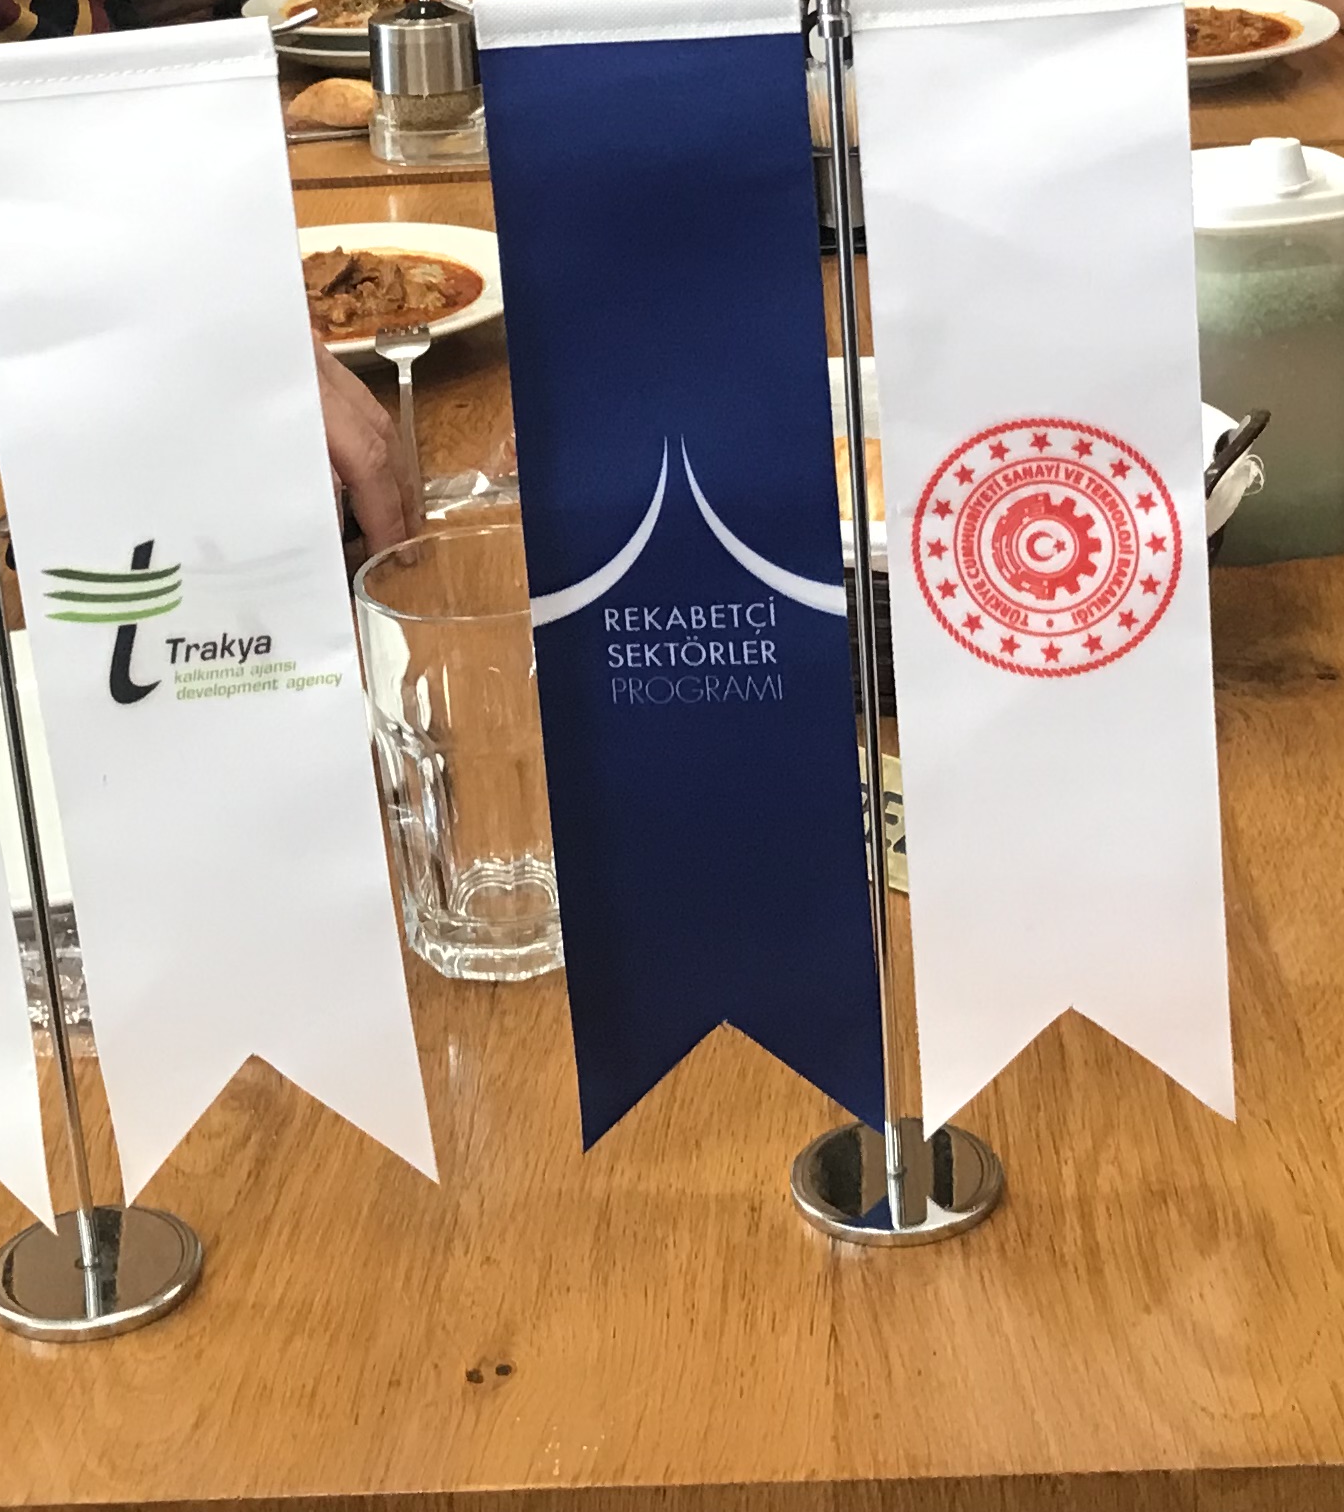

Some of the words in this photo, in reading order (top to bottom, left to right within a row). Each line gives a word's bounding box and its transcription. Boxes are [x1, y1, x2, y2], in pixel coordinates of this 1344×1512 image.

[604, 595, 777, 636] REKABETÇİ
[165, 633, 272, 664] Trakya
[608, 635, 778, 669] SEKTÖRLER
[174, 665, 245, 684] kalkınma
[176, 678, 278, 701] development
[286, 672, 343, 692] agency
[611, 674, 783, 705] PROGRAMI
